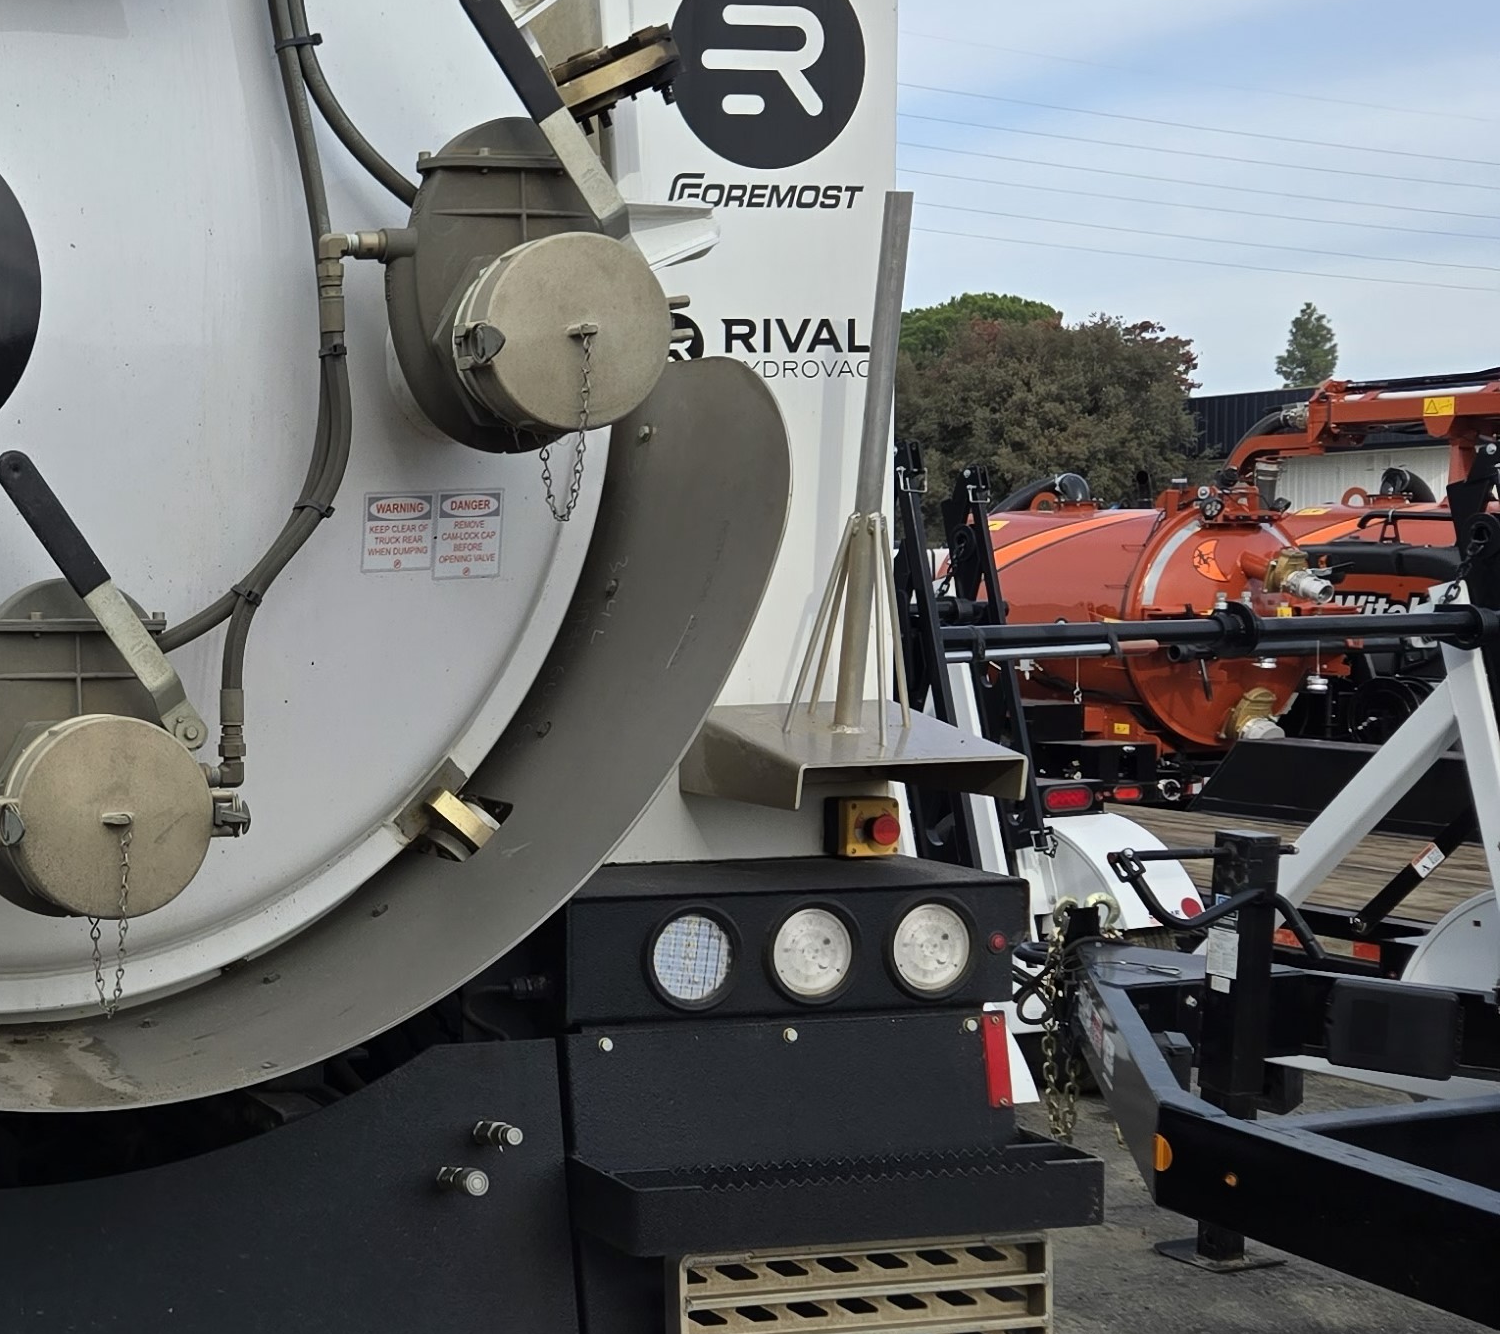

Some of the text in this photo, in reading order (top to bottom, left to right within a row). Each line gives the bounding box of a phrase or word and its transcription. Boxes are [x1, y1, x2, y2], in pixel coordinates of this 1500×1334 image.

[668, 173, 864, 209] FOREMOST
[721, 318, 870, 353] RIVAL
[743, 360, 869, 378] YDROVAC
[376, 502, 425, 514] WARNING
[450, 500, 491, 511] DANGER
[369, 523, 429, 534] KEEP CLEAR OF
[453, 520, 485, 529] REMOVE
[374, 535, 423, 545] TRUCK REAR
[441, 531, 496, 541] CAM-LOCK CAP
[368, 546, 428, 556] WHEN DUMPING
[453, 543, 483, 552] BEFORE
[439, 553, 495, 563] OPENING VALVE
